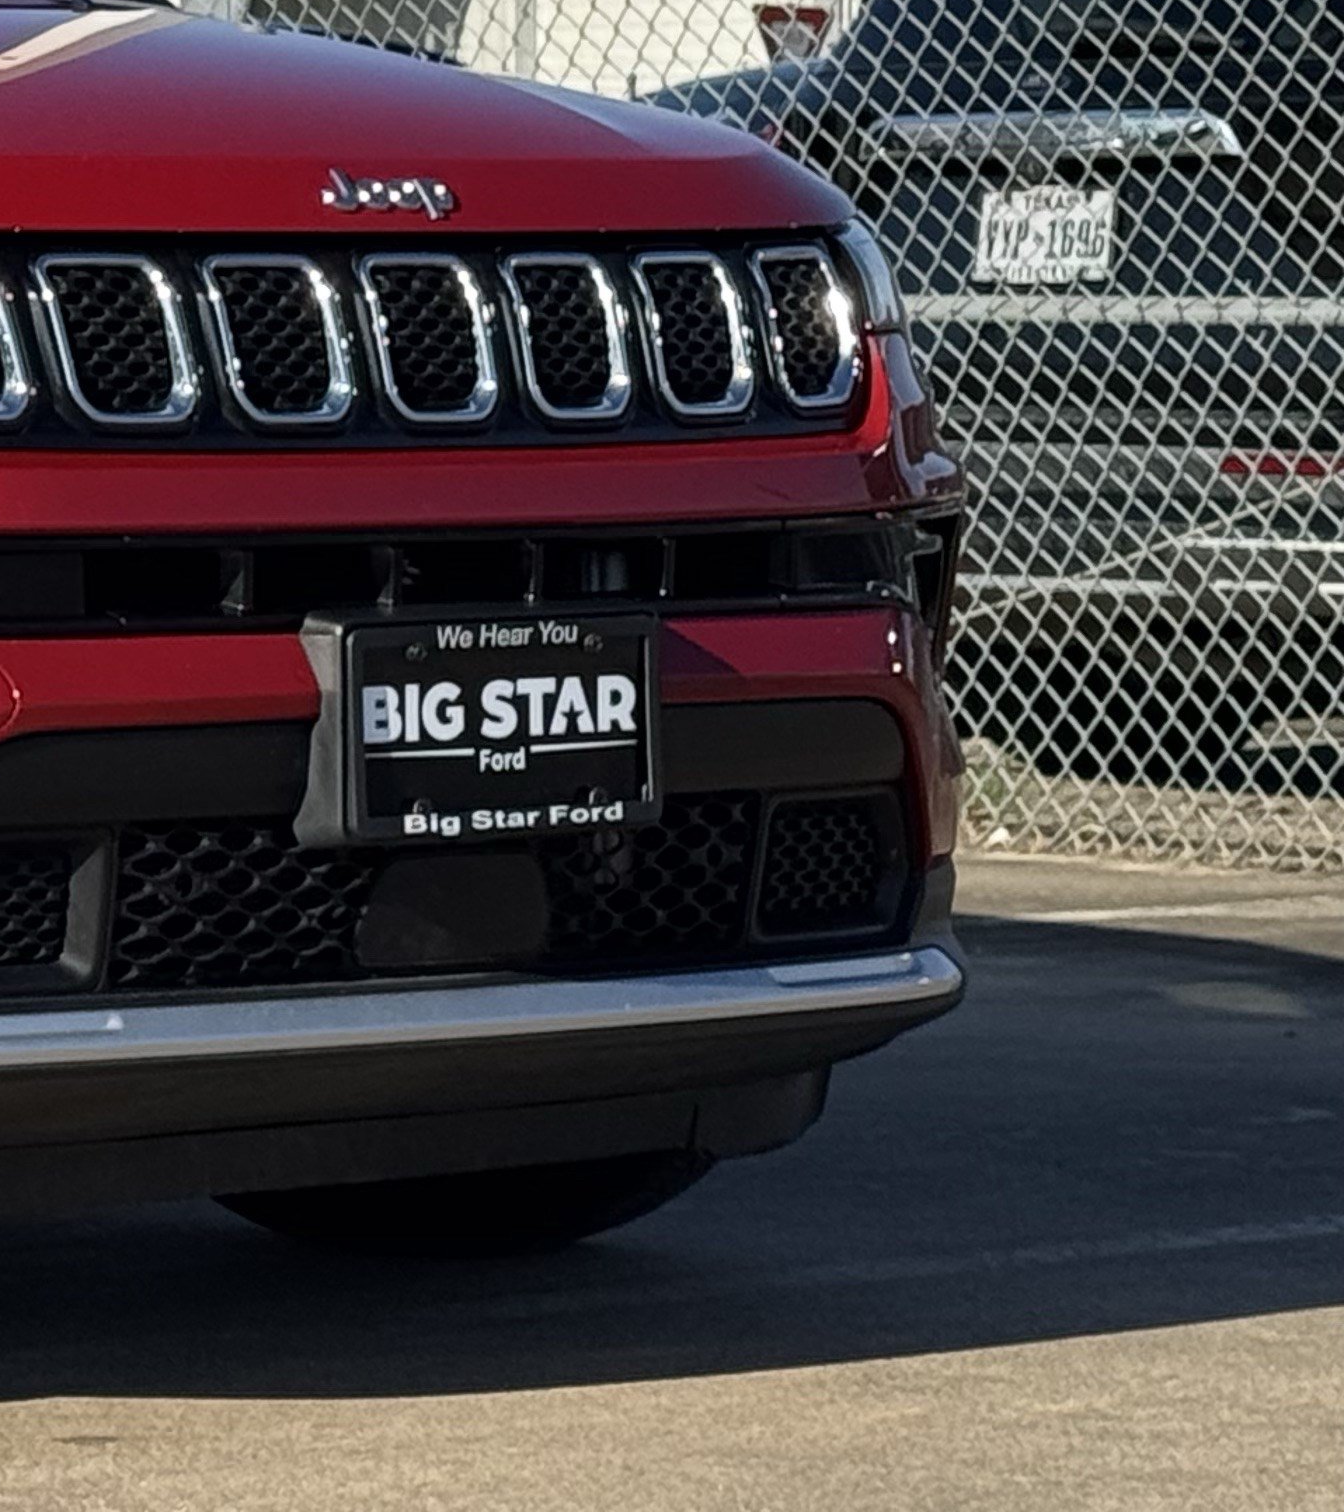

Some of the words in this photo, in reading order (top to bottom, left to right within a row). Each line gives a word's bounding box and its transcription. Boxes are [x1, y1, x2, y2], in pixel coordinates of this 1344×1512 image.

[322, 168, 455, 221] Jeep
[436, 624, 474, 650] We
[479, 622, 535, 649] Hear
[537, 620, 579, 645] You
[362, 681, 466, 744] BIG
[480, 674, 638, 741] STAR
[479, 746, 527, 773] Ford
[403, 812, 462, 837] Big
[471, 807, 540, 830] Star
[549, 800, 625, 826] Ford
